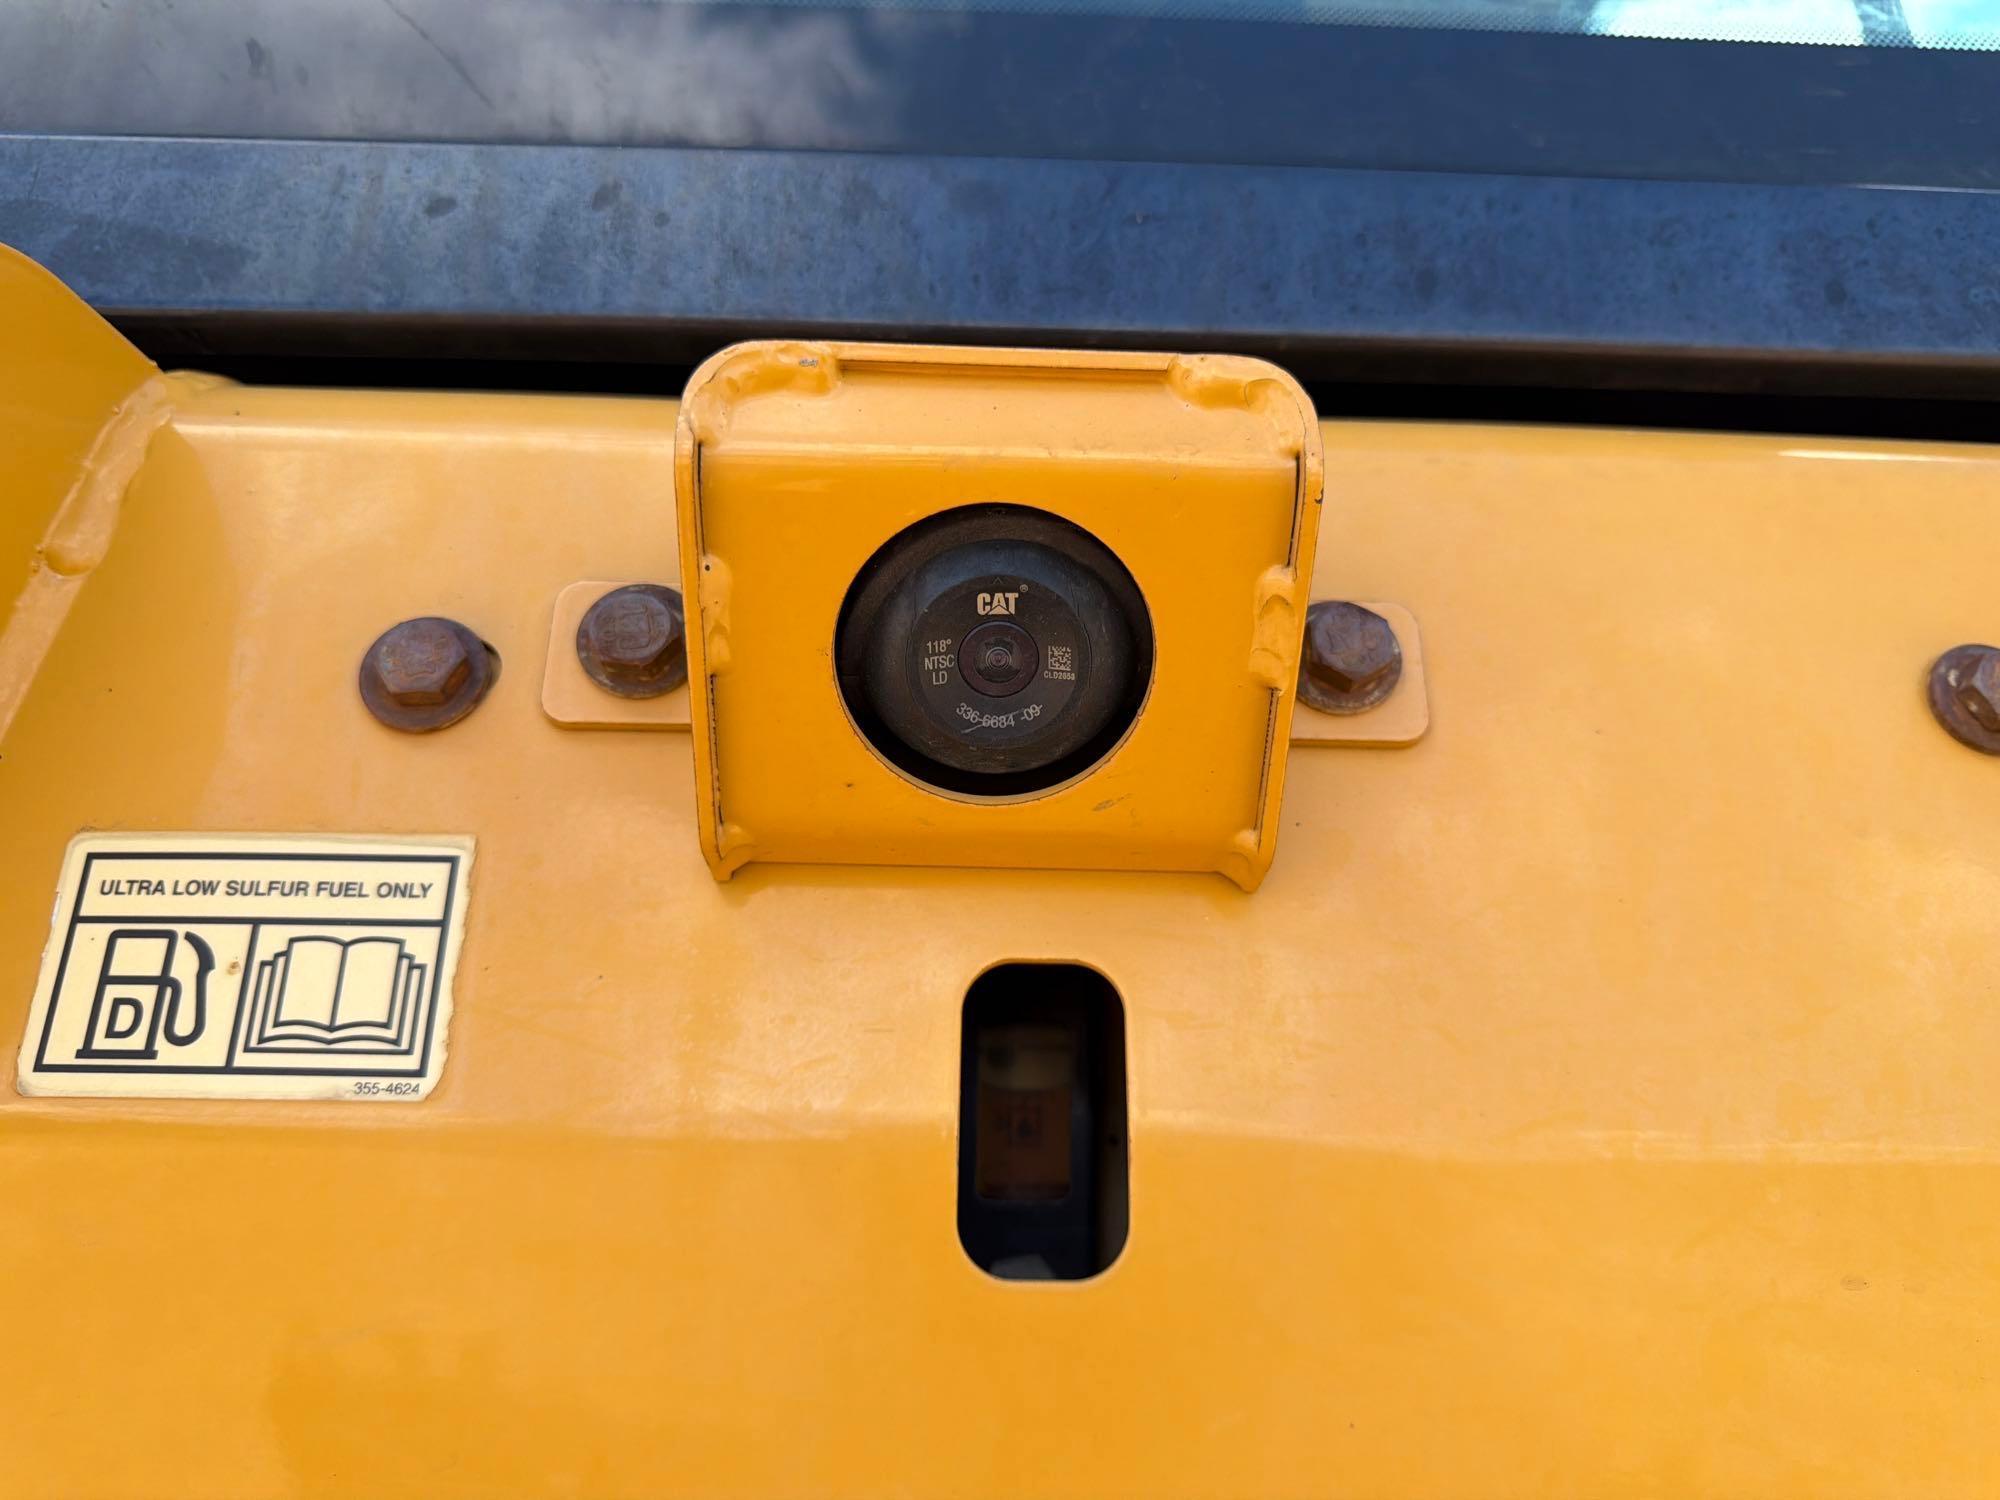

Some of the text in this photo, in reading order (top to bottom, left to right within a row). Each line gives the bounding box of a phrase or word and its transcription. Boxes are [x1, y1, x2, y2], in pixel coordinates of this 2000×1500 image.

[926, 638, 952, 654] 118°
[924, 654, 955, 671] NTSC
[932, 671, 948, 685] LD
[956, 702, 1016, 729] 336-6684
[99, 879, 434, 899] ULTRA LOW SULFUR FUEL ONLY
[105, 997, 143, 1039] D
[353, 1082, 420, 1095] 355-4624
